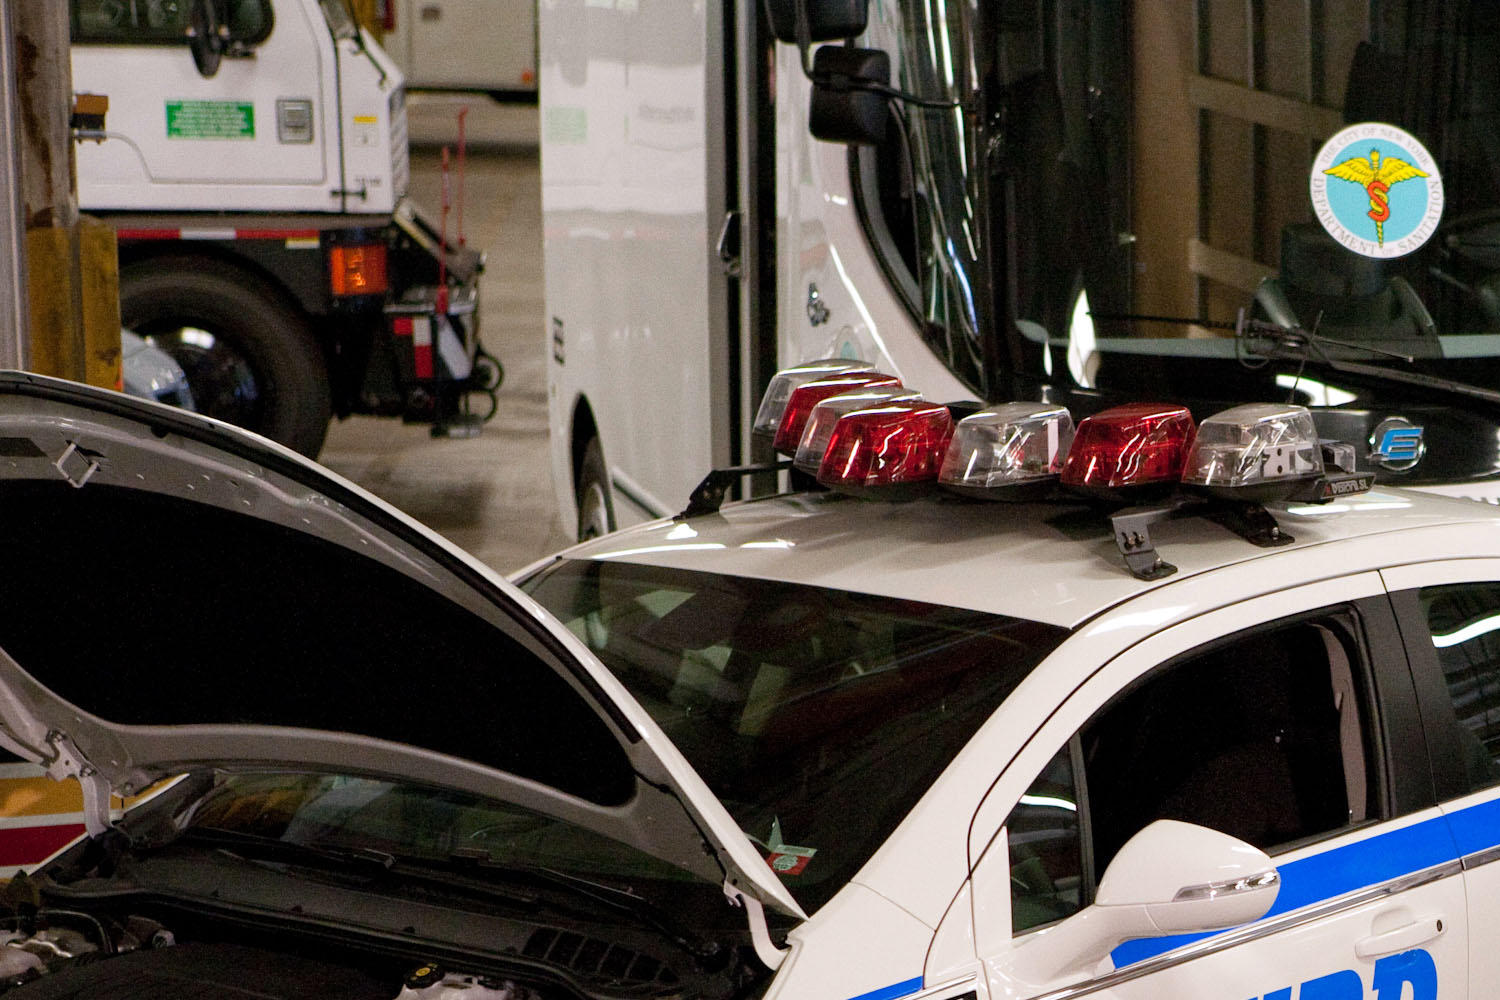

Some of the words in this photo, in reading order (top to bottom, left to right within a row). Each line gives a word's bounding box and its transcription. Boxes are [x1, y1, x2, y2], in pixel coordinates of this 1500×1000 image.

[1338, 130, 1360, 146] CITY
[1362, 127, 1377, 136] OF
[1381, 128, 1403, 141] NEW
[1406, 140, 1431, 165] YORK
[1313, 178, 1377, 255] DEPARTMENT
[1398, 180, 1440, 252] SANITATION
